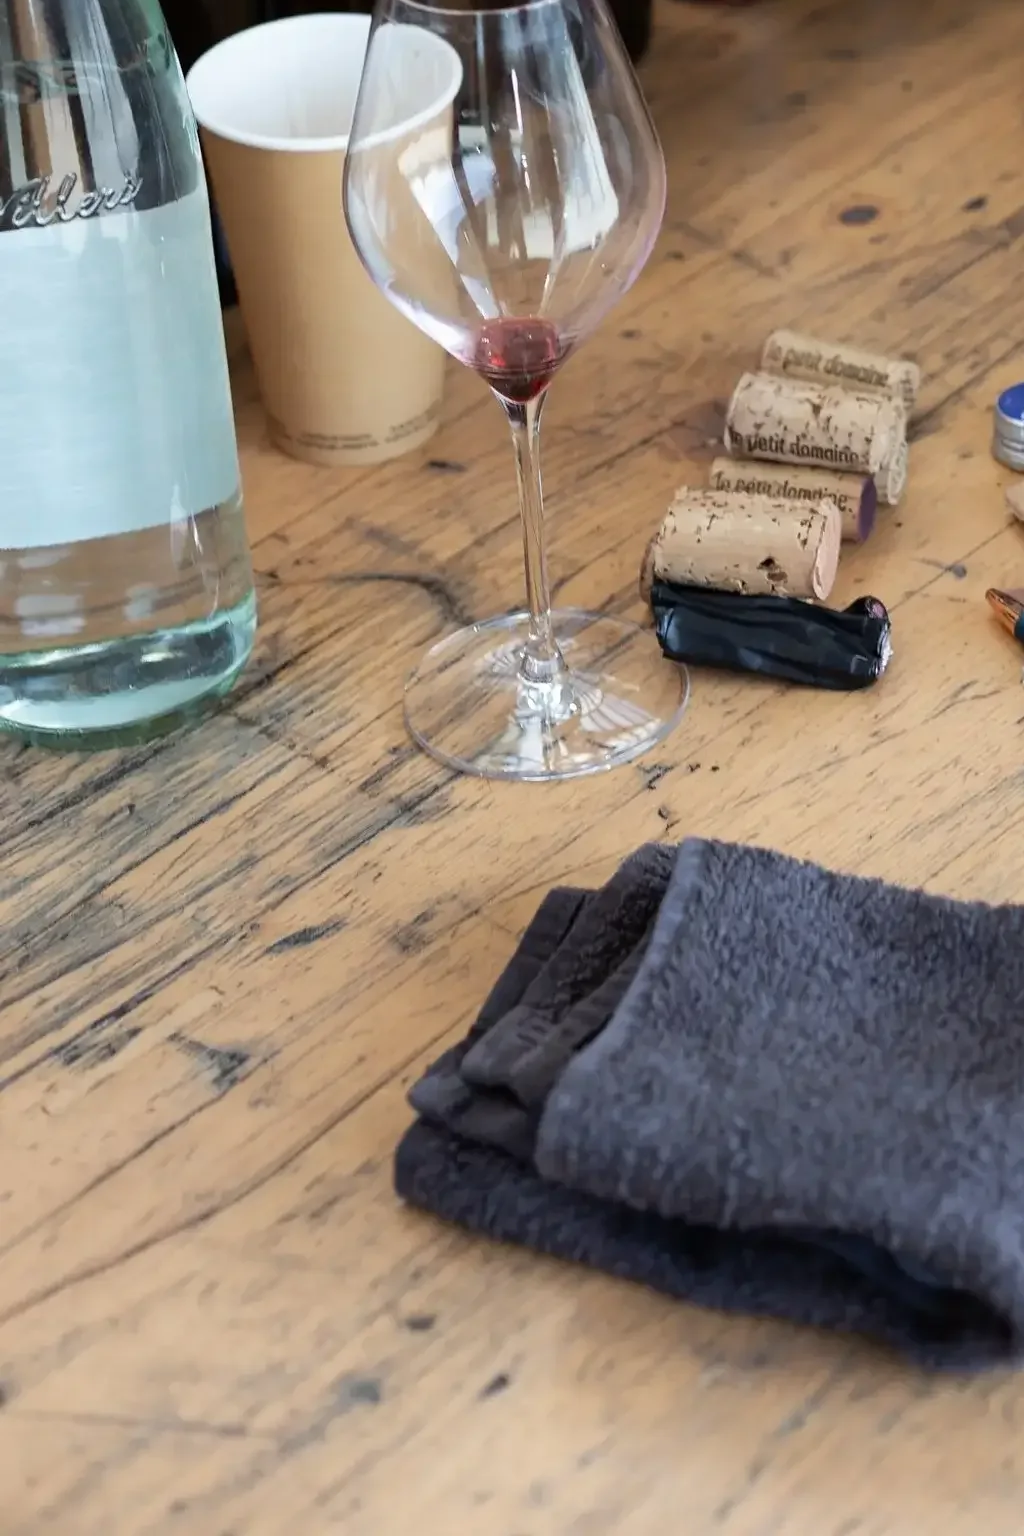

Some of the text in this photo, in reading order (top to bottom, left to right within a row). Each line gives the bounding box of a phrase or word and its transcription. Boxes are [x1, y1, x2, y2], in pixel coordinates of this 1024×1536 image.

[783, 348, 822, 372] petit
[823, 354, 890, 388] domaine
[747, 432, 786, 456] petit
[789, 434, 861, 464] domaine
[735, 478, 773, 497] petit
